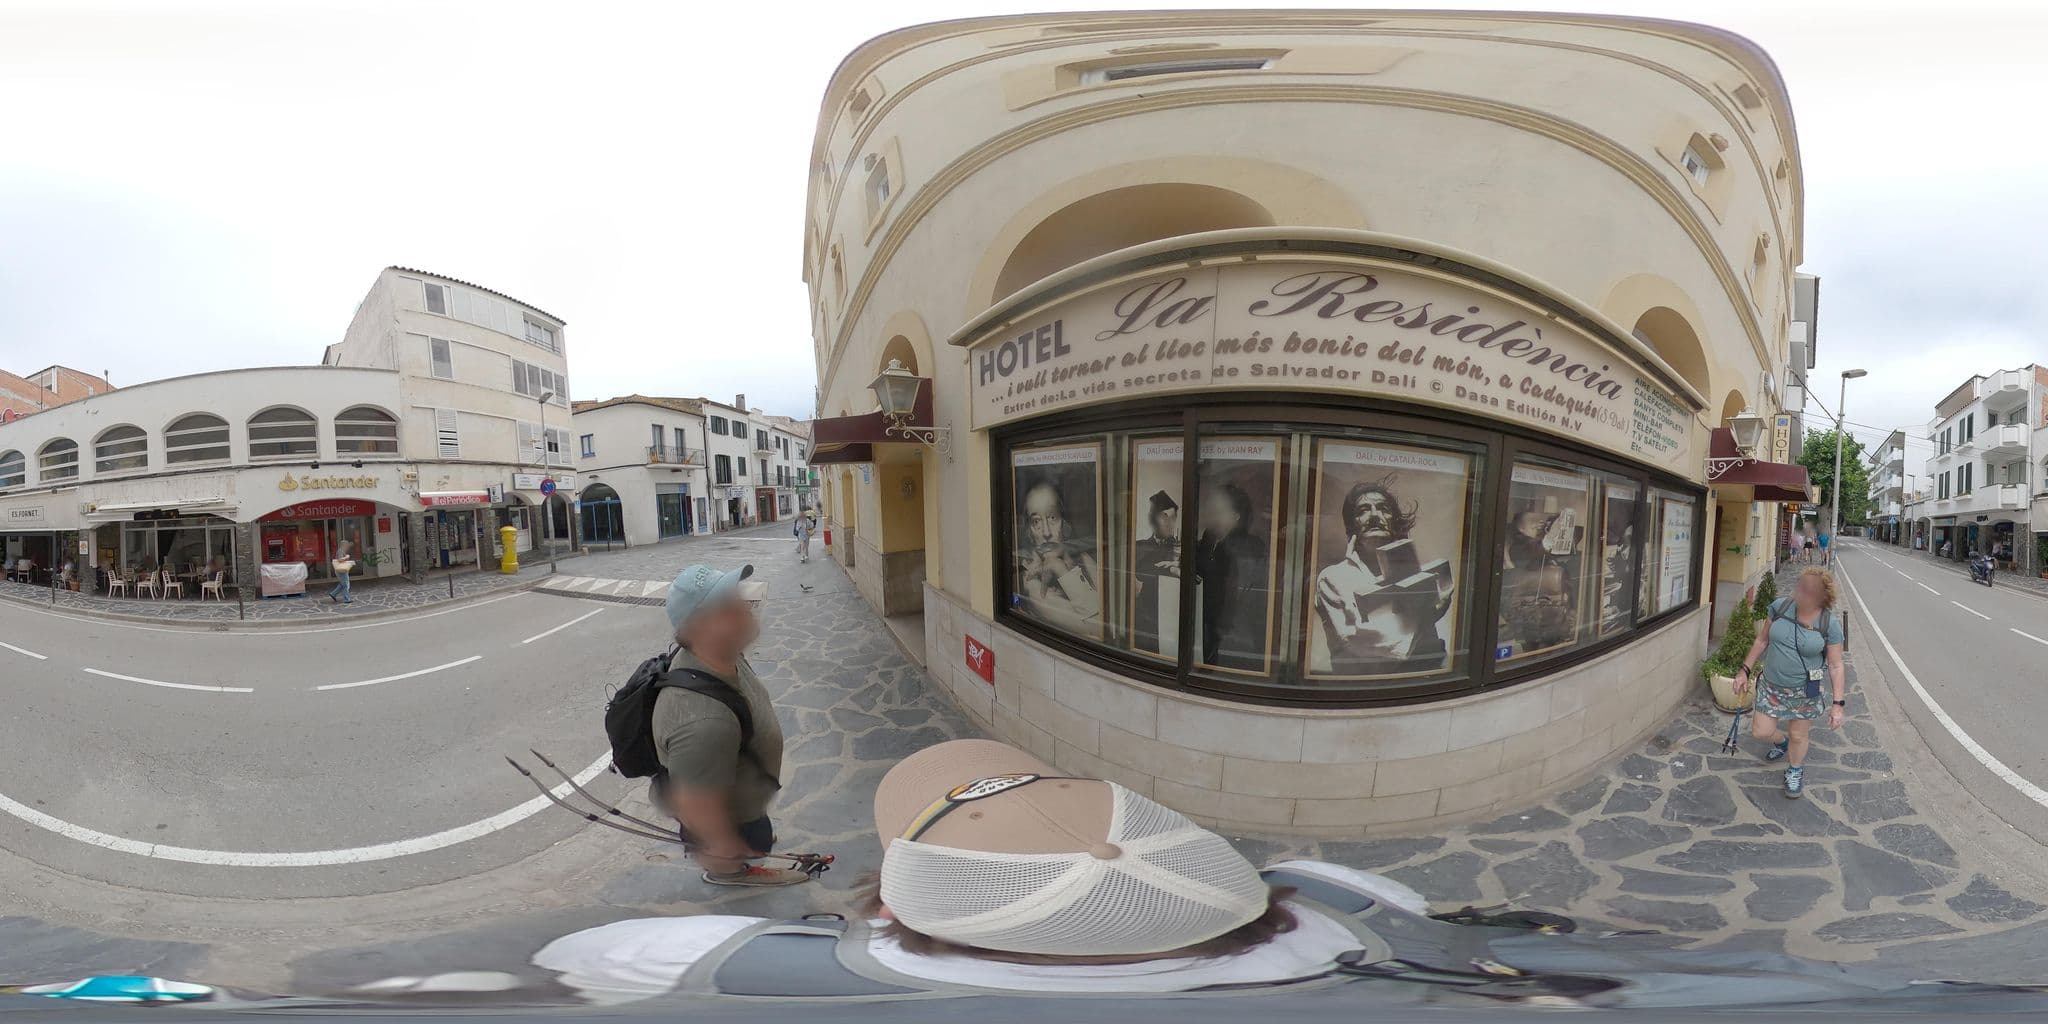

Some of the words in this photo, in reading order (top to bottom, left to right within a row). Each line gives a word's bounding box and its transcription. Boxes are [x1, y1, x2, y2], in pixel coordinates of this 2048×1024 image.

[979, 319, 1071, 387] HOTEL
[1094, 277, 1215, 341] La
[1248, 270, 1623, 401] Residència
[1003, 399, 1036, 415] Extret
[1082, 380, 1116, 396] vida
[1124, 366, 1202, 388] secreta
[1212, 364, 1240, 378] de
[1250, 362, 1361, 381] Salvador
[1456, 385, 1500, 408] Dasa
[1007, 382, 1014, 398] i
[1016, 369, 1047, 394] vull
[1051, 353, 1116, 385] tornar
[1120, 343, 1150, 368] al
[1154, 337, 1206, 362] lloc
[1214, 330, 1274, 354] més
[1282, 330, 1369, 358] bonic
[1377, 340, 1427, 366] del
[1432, 354, 1491, 387] món,
[1499, 374, 1513, 389] a
[1519, 375, 1599, 419] Cadaqués
[1248, 446, 1264, 454] RAY
[1776, 430, 1788, 458] HOT
[301, 475, 380, 490] Santander
[298, 504, 356, 516] Santander
